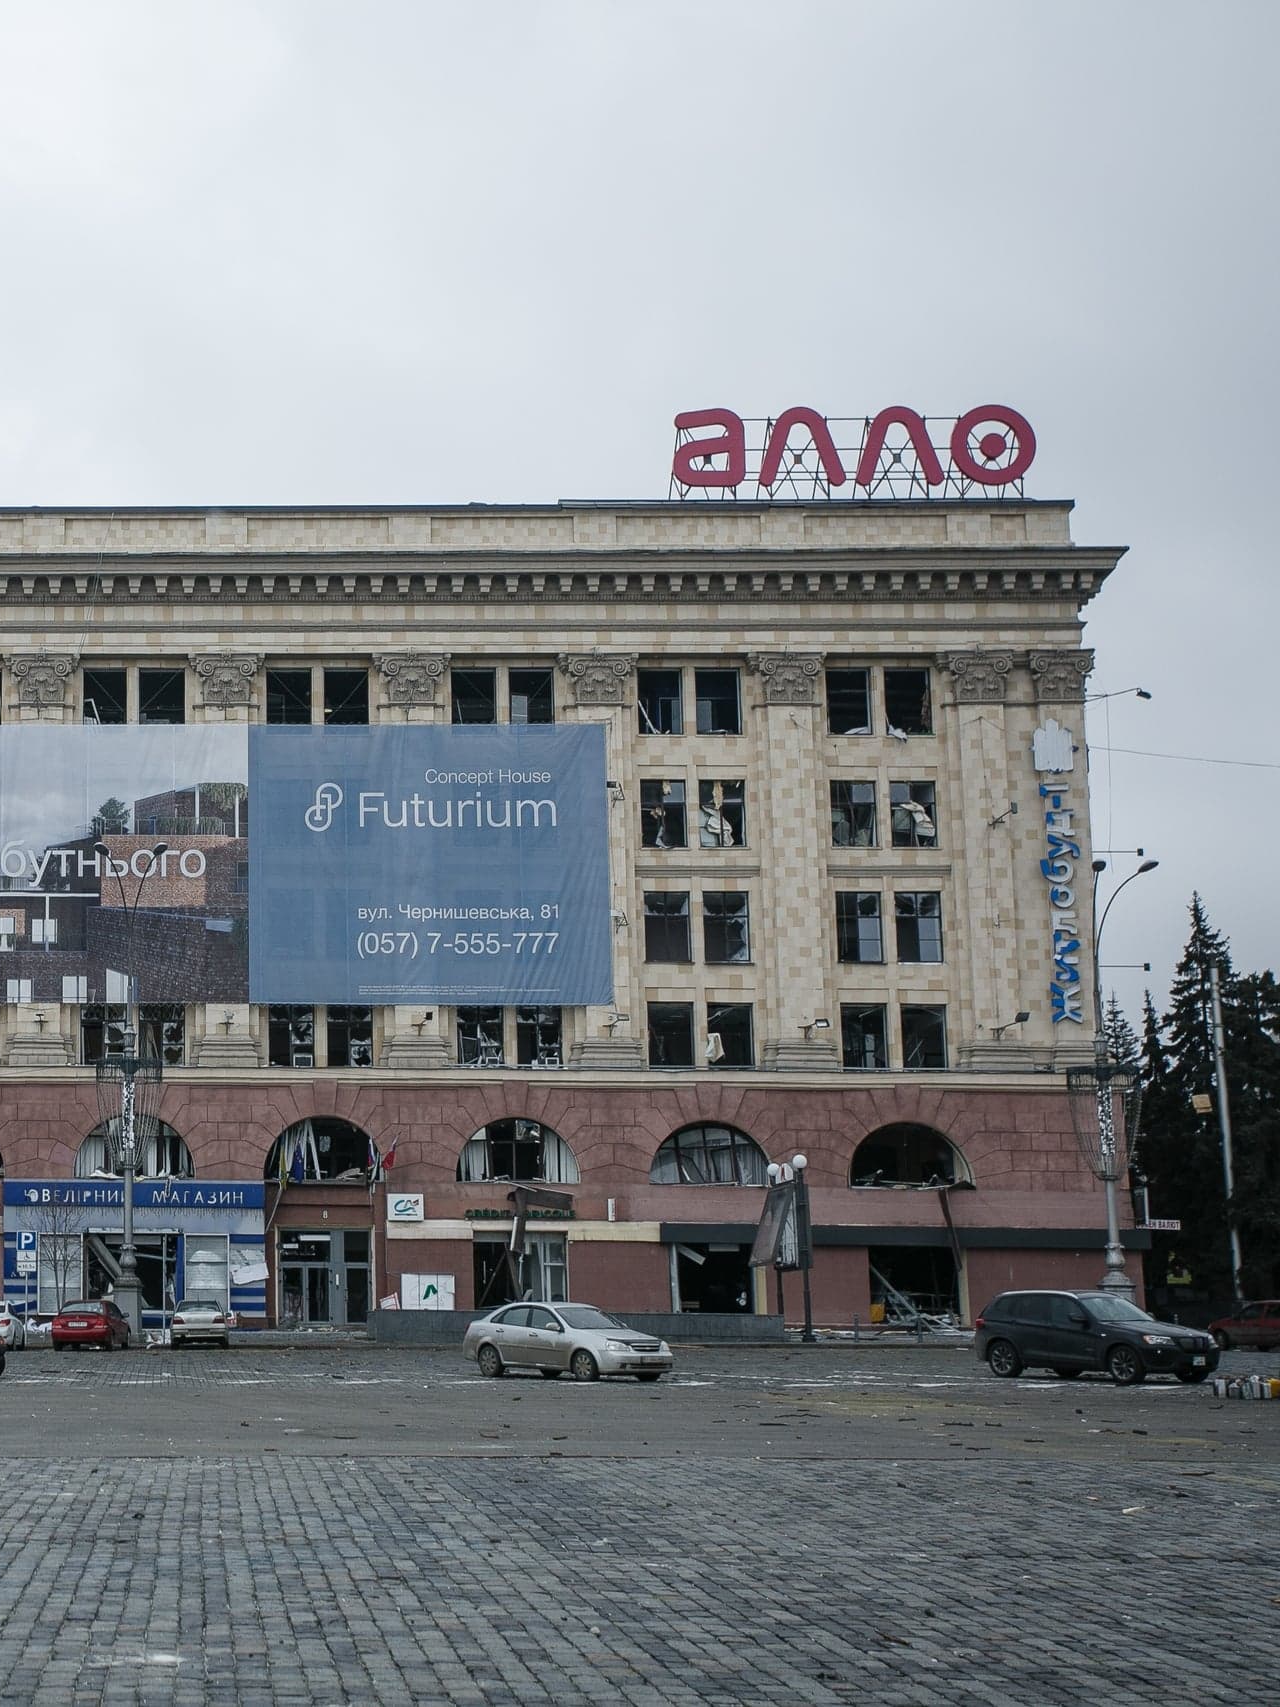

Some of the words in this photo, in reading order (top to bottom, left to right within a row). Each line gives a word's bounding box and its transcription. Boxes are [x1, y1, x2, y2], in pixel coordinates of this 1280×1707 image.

[425, 768, 493, 786] Concept
[499, 768, 551, 784] House
[359, 791, 558, 828] Futurium
[358, 907, 392, 923] вул.
[399, 904, 534, 923] Чернишевська,
[541, 904, 558, 919] 81
[357, 932, 418, 959] (057)
[428, 932, 559, 954] 7-555-777
[24, 1189, 124, 1203] ЮВЕЛІРНИ
[152, 1190, 243, 1204] МАГАЗИН
[21, 1232, 33, 1249] P
